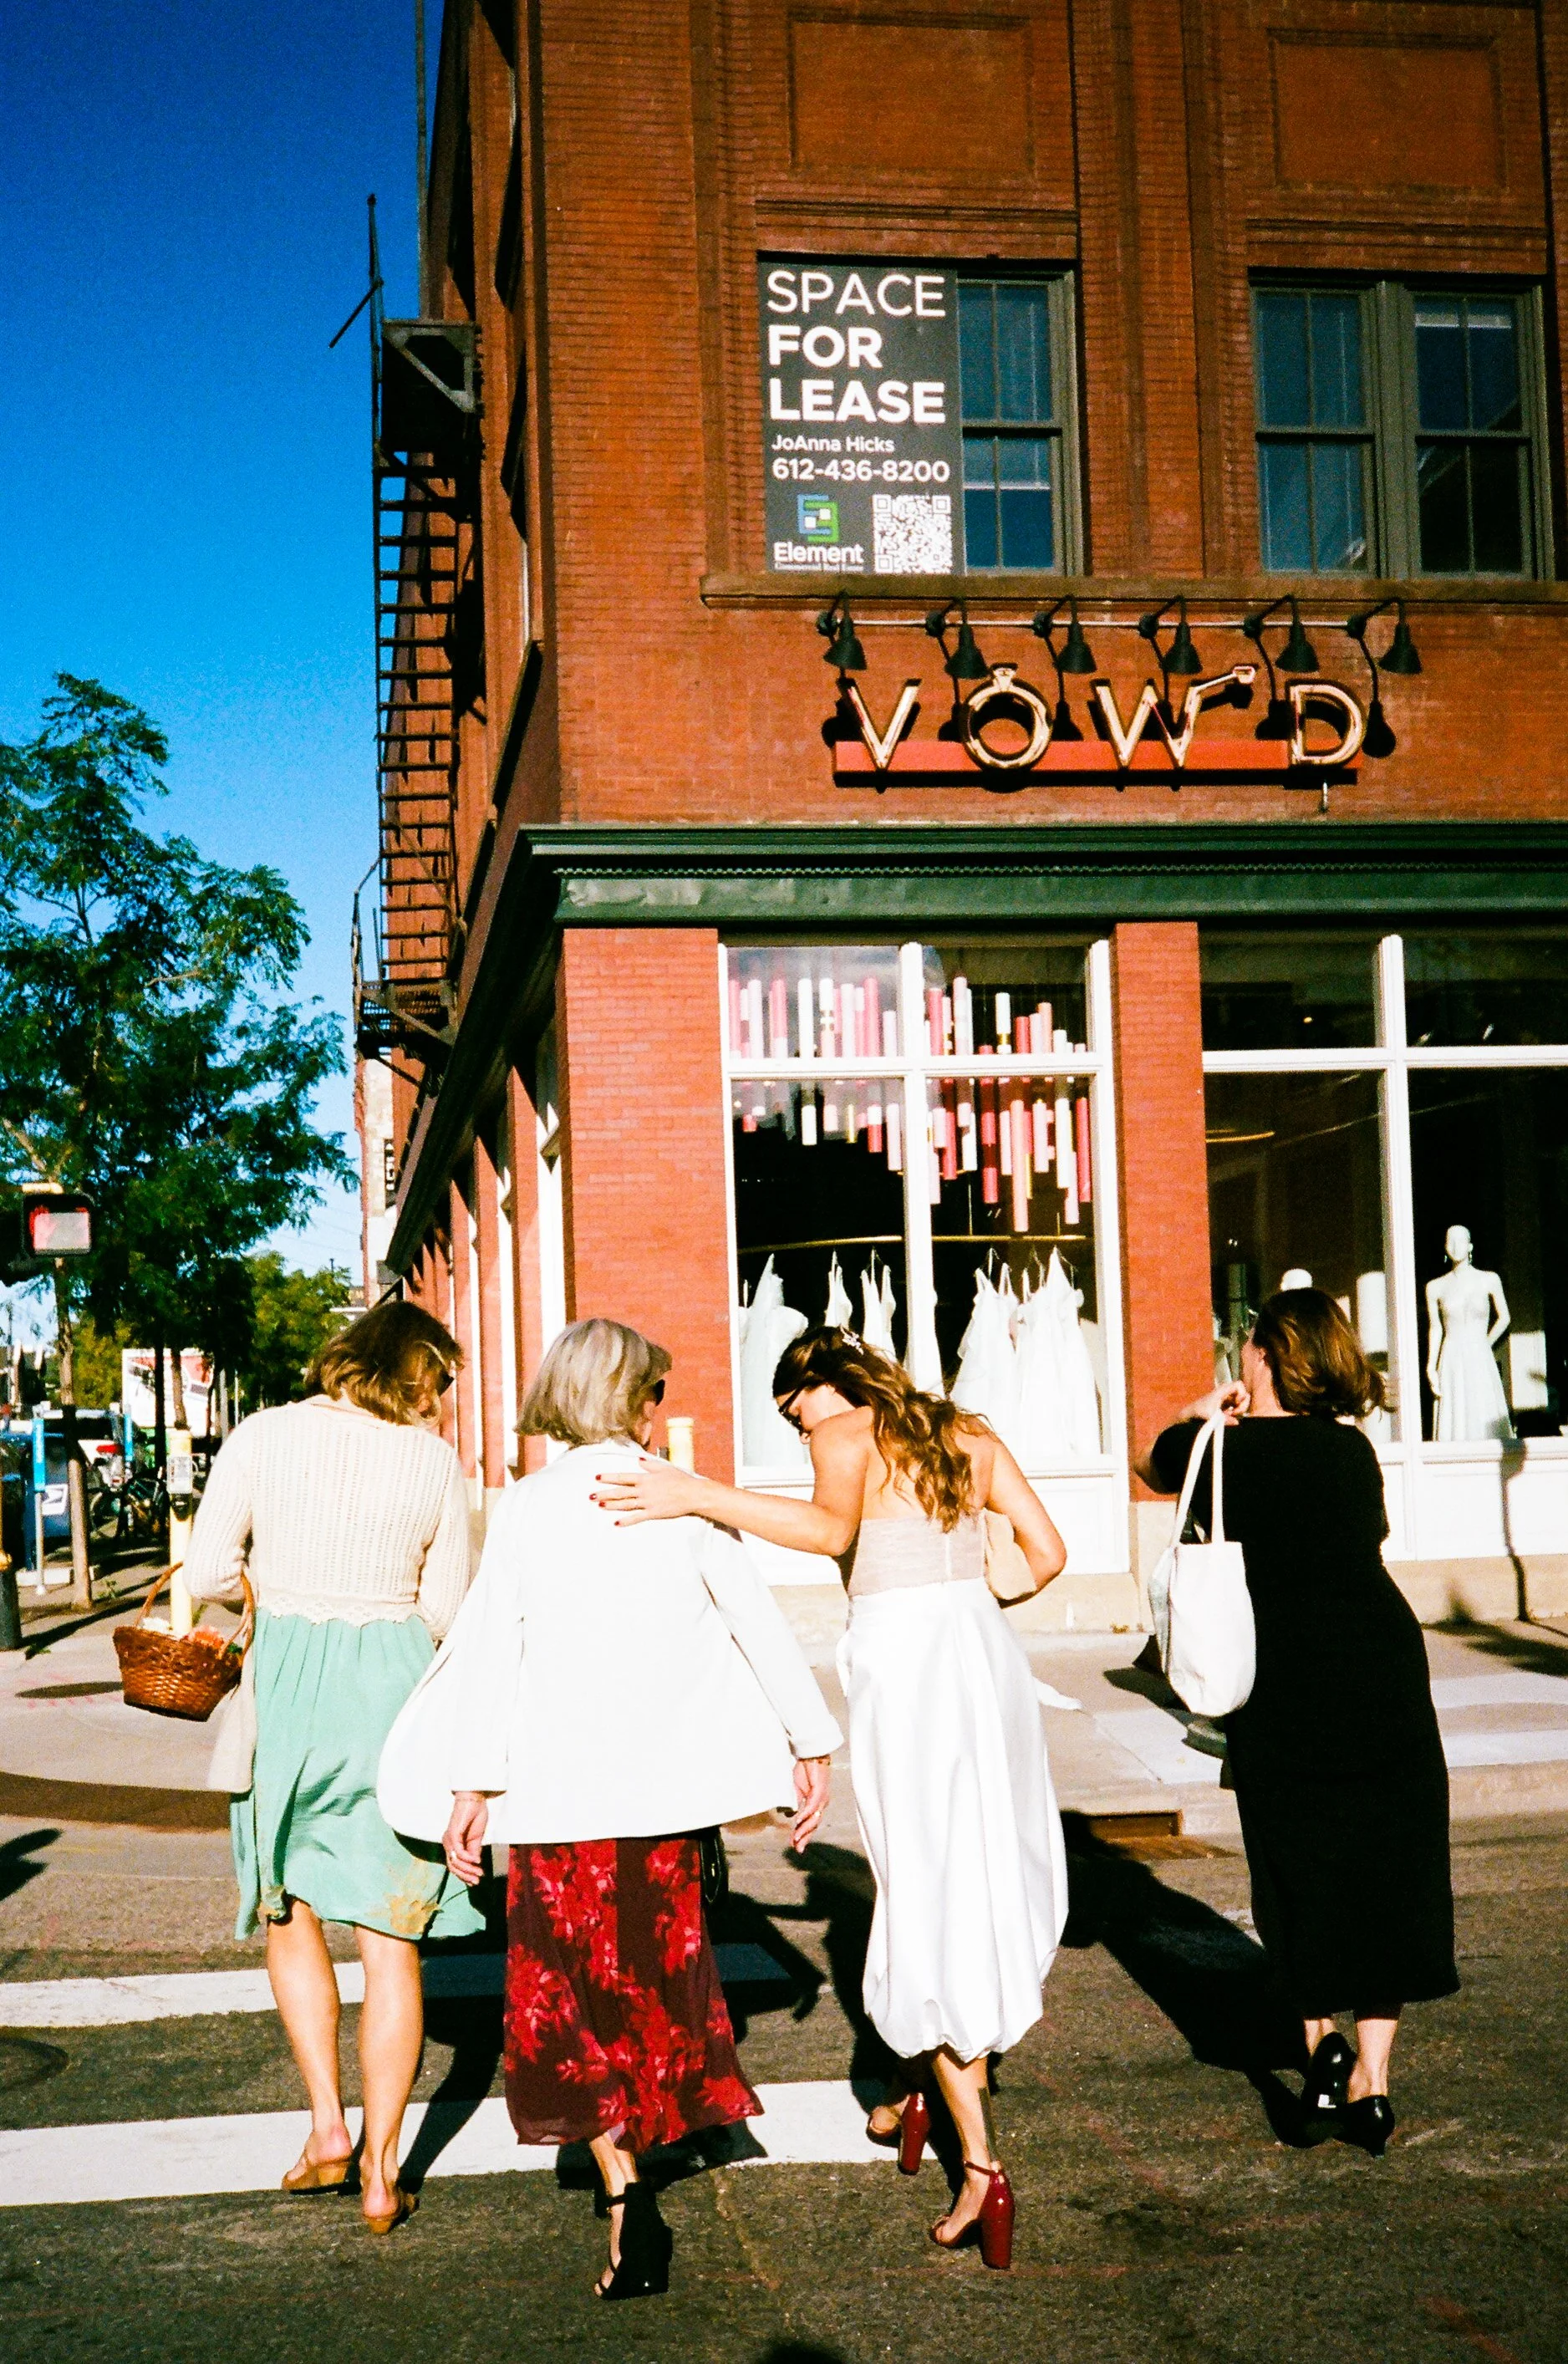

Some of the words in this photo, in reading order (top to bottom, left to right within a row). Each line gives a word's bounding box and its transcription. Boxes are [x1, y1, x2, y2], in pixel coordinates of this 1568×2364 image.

[766, 270, 946, 317] SPACE
[768, 324, 883, 369] FOR
[769, 378, 946, 424] LEASE
[771, 435, 841, 452] JoAnna
[846, 436, 895, 453] Hicks
[772, 457, 950, 482] 612-436-8200
[773, 542, 864, 563] Element
